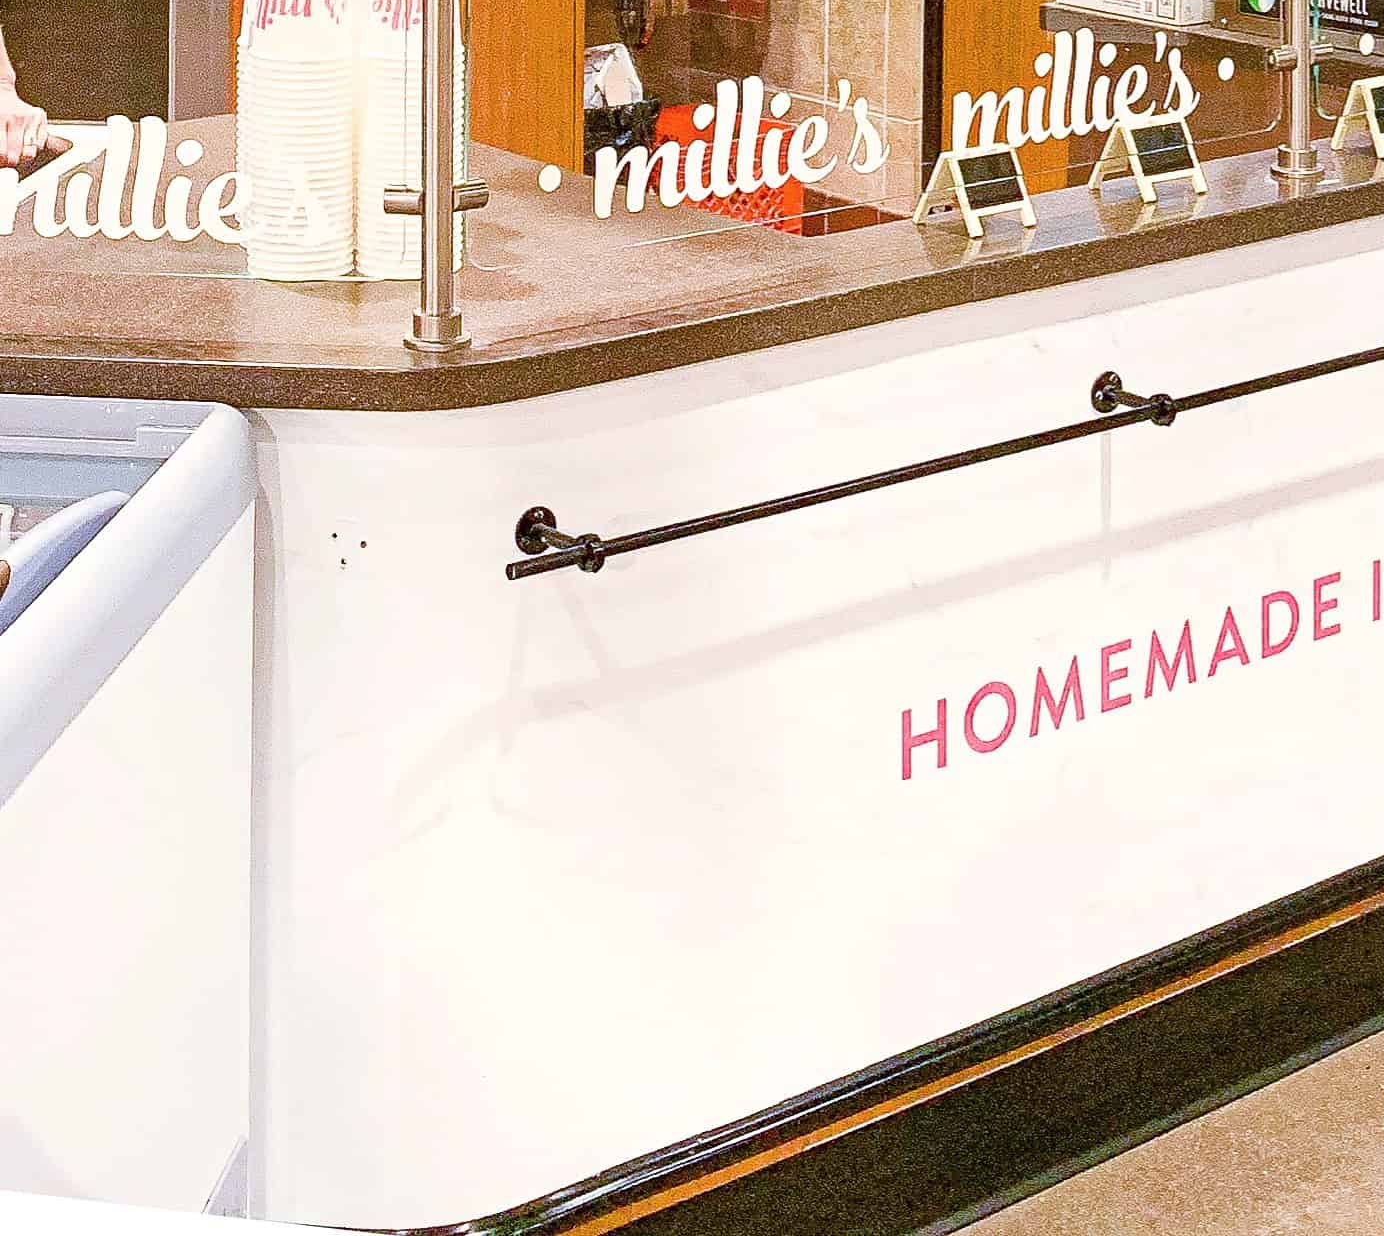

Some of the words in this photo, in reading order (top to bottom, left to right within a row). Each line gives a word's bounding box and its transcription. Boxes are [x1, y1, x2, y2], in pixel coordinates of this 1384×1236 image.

[0, 114, 258, 249] millie
[594, 75, 890, 220] millie's
[952, 27, 1201, 152] millie's
[901, 572, 1342, 781] HOMEMADE
